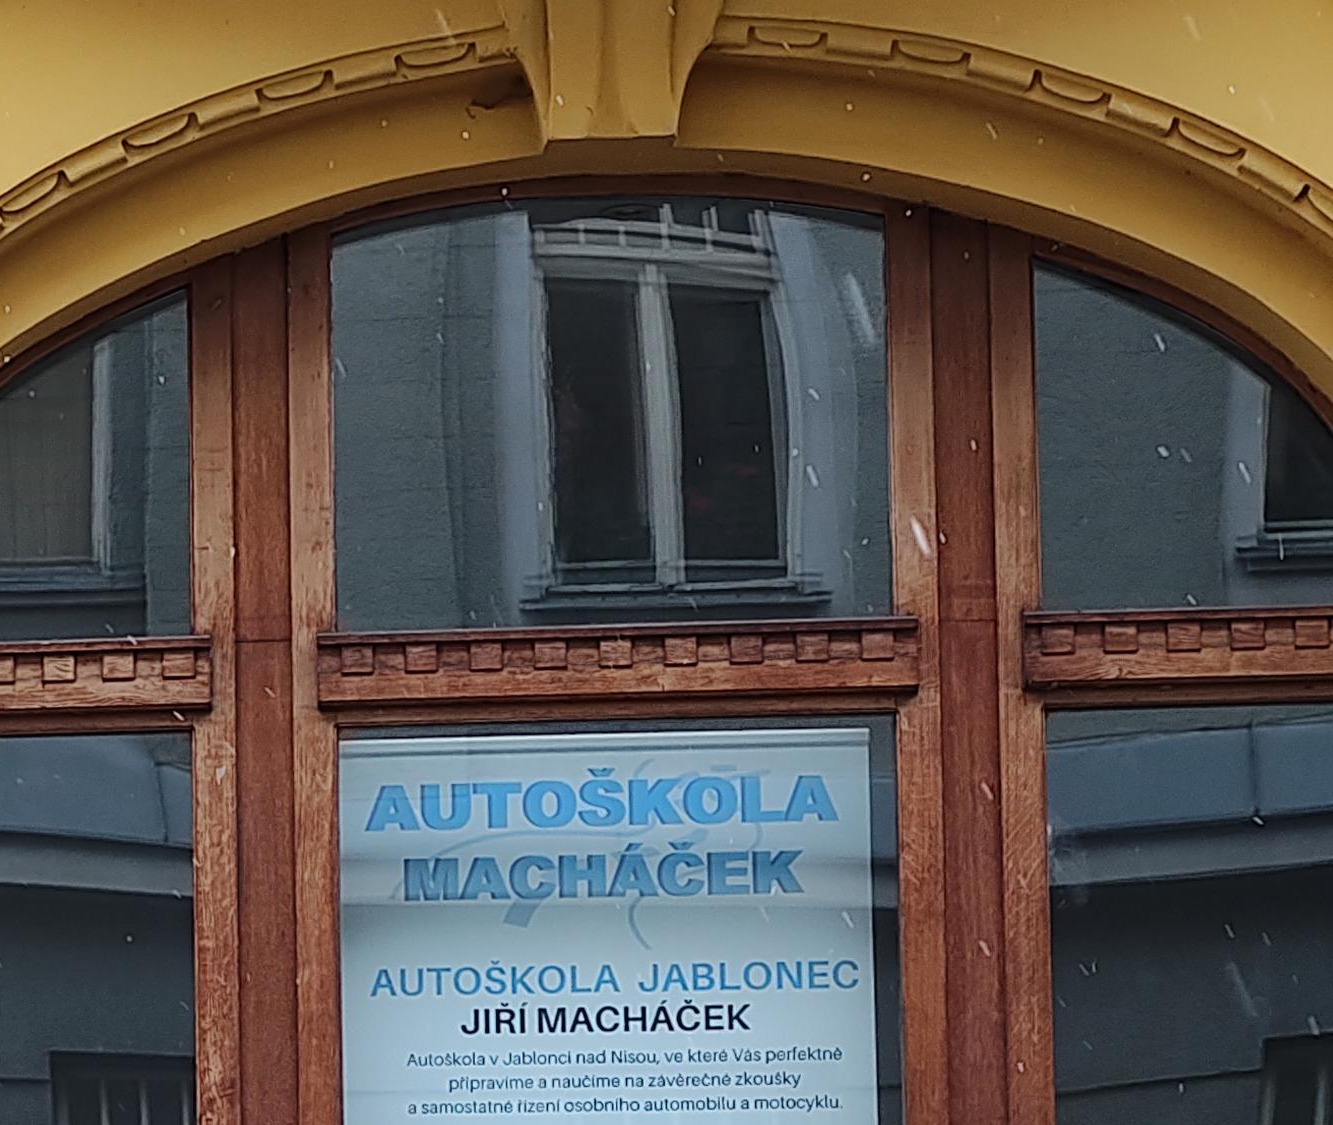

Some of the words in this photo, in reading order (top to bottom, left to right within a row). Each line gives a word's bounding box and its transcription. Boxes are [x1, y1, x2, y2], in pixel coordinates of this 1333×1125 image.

[365, 767, 838, 832] AUTOŠKOLA
[403, 842, 803, 901] MACHÁČEK
[370, 959, 620, 997] AUTOŠKOLA
[638, 959, 859, 992] JABLONEC
[461, 1002, 527, 1034] JIŘÍ
[538, 999, 751, 1032] MACHÁČEK
